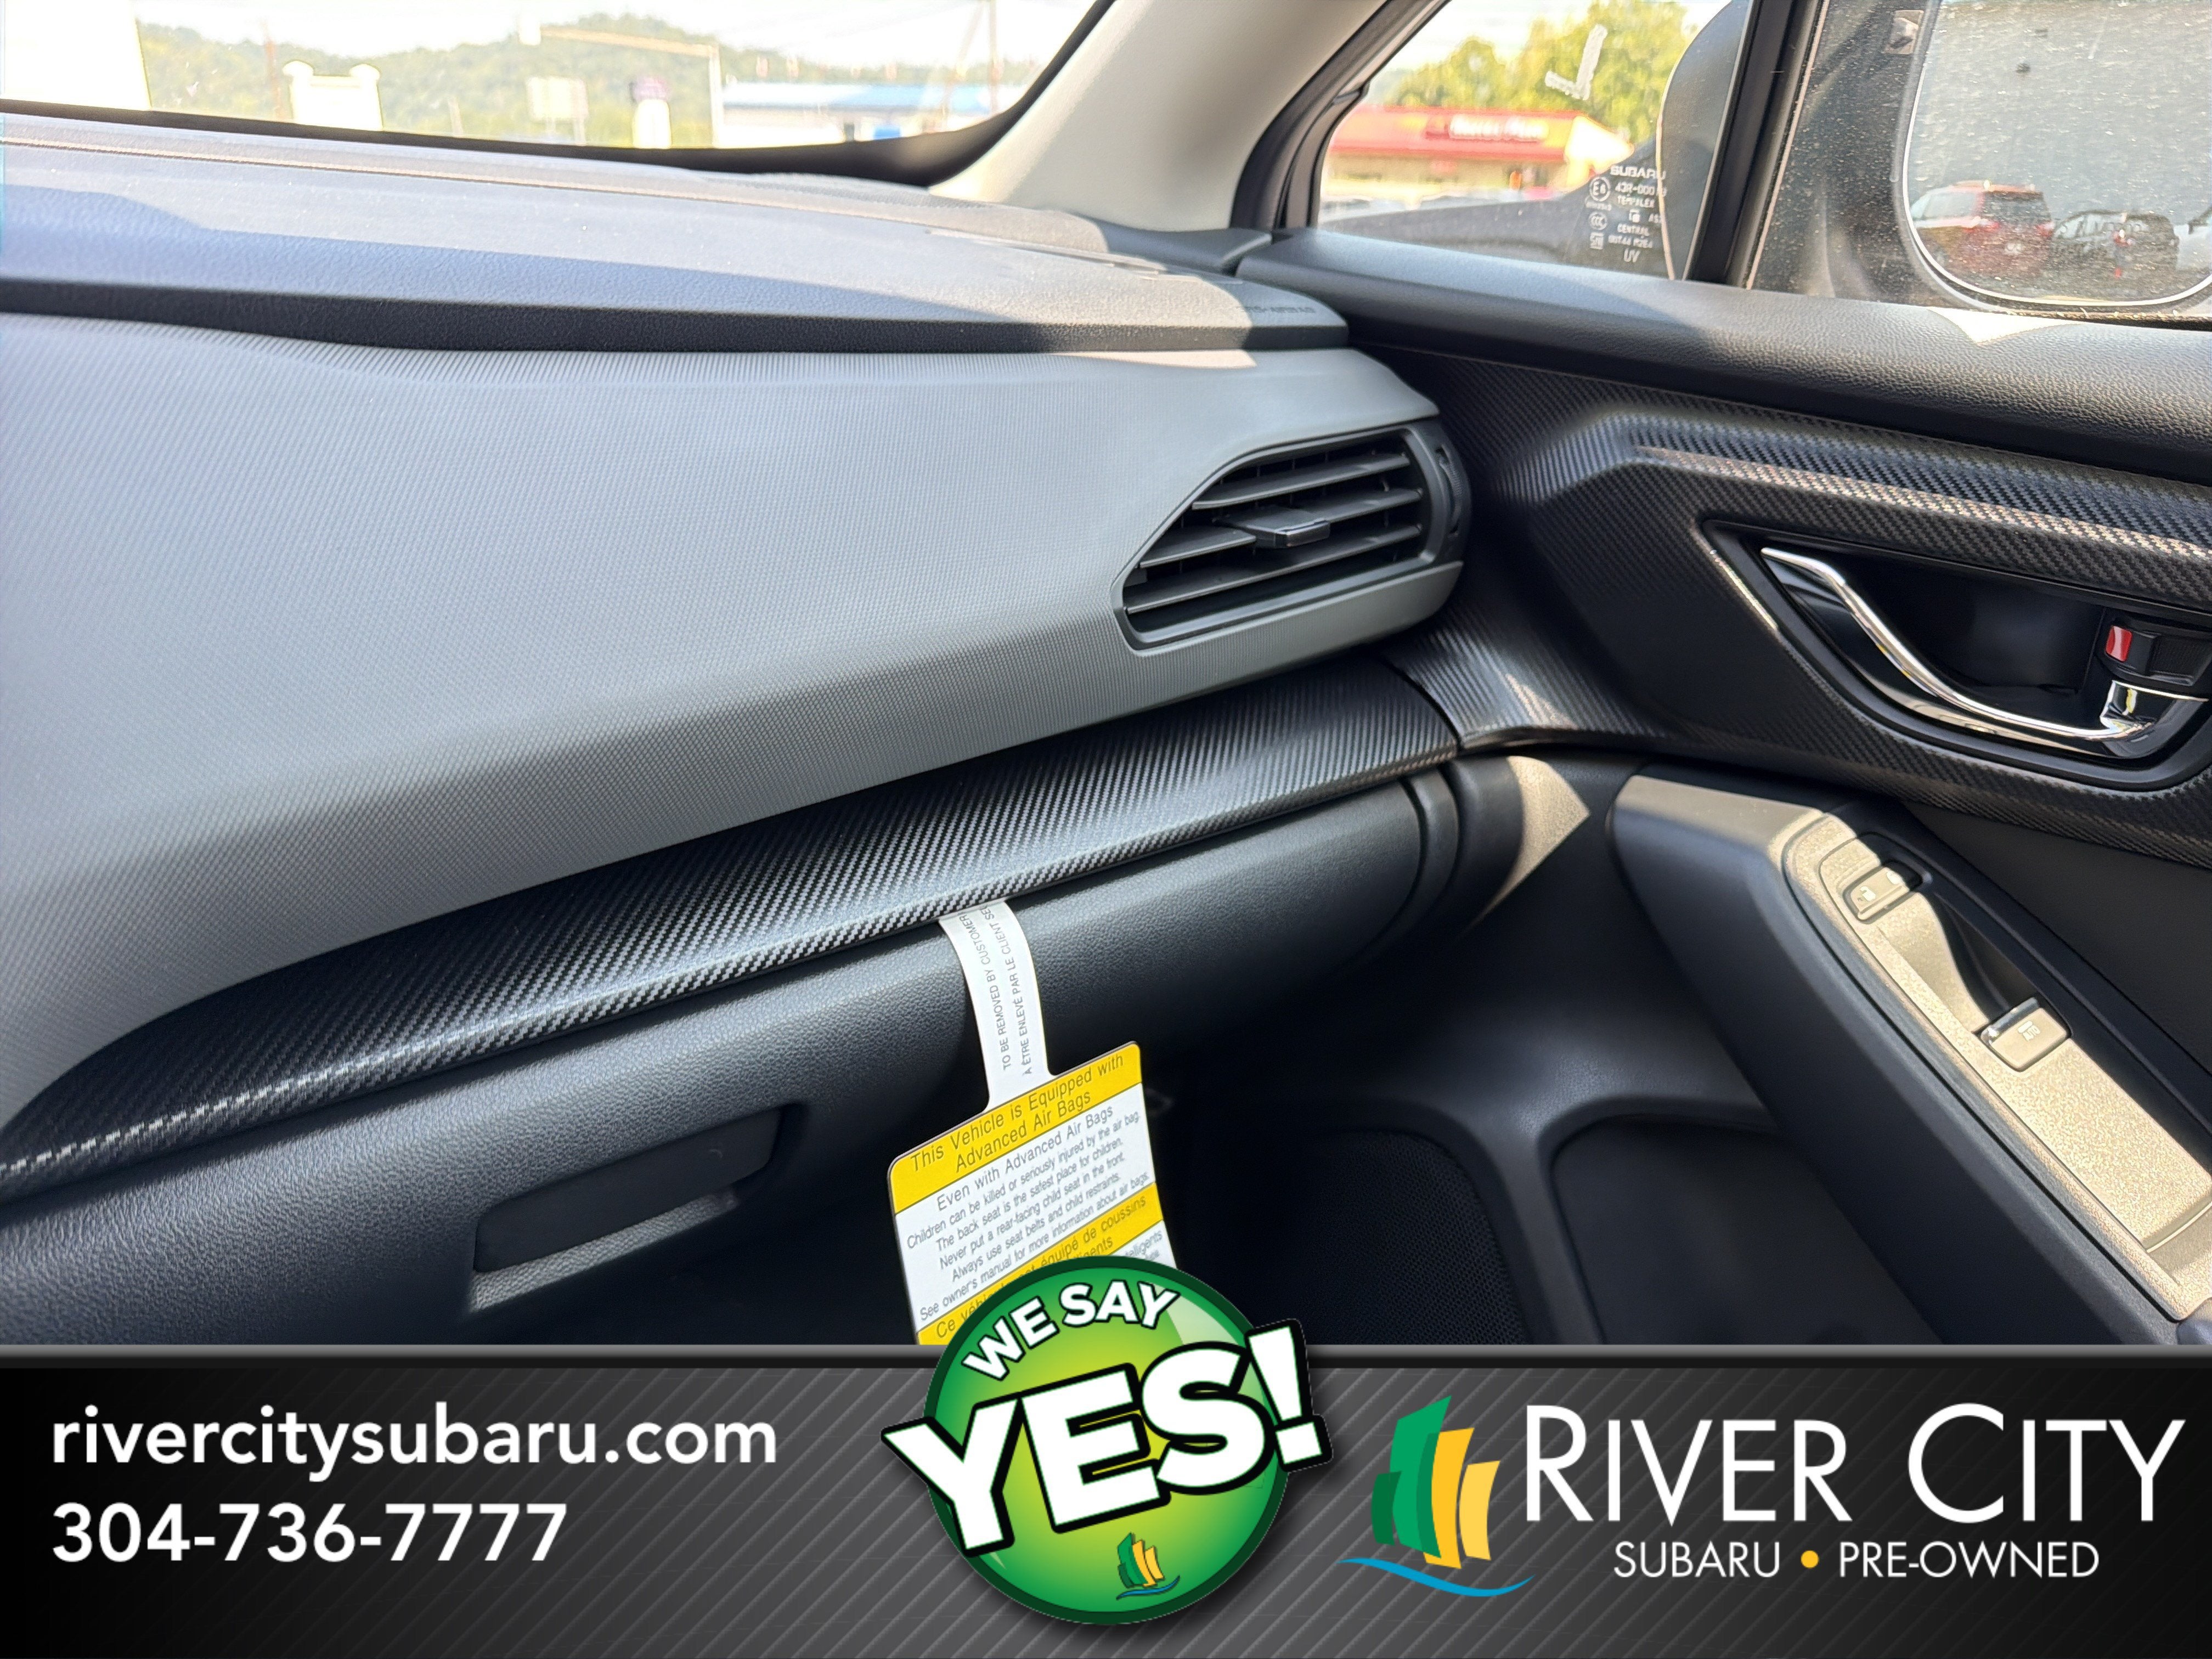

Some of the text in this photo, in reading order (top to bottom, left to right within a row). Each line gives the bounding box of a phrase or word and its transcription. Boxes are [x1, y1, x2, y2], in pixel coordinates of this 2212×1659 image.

[1610, 166, 1666, 180] SUBARU
[1623, 247, 1641, 263] UV
[989, 923, 1011, 955] CLIENT
[1005, 957, 1016, 970] LE
[1009, 973, 1021, 995] PAR
[959, 915, 1012, 1070] TO BE REMOVED BY CUSTOMER
[911, 1054, 1124, 1171] This Vehicle is Equipped with
[936, 1105, 1113, 1211] Even with Advanced Air Bags
[956, 1091, 1091, 1173] Advanced Air Bags
[907, 1220, 946, 1249] Children
[949, 1209, 966, 1225] can
[969, 1200, 980, 1214] be
[983, 1183, 1006, 1205] killed
[1008, 1179, 1017, 1191] or
[1021, 1157, 1055, 1184] seriously
[1058, 1139, 1084, 1163] injured
[1086, 1135, 1096, 1148] by
[1098, 1126, 1110, 1140] the
[1113, 1119, 1122, 1132] air
[936, 1234, 955, 1251] The
[957, 1219, 979, 1240] back
[983, 1206, 1001, 1226] seat
[1003, 1201, 1011, 1213] is
[1013, 1192, 1027, 1207] the
[1030, 1175, 1054, 1198] safest
[1057, 1163, 1077, 1184] place
[1079, 1155, 1090, 1168] for
[940, 1245, 967, 1269] Never
[970, 1235, 985, 1255] put
[988, 1231, 994, 1241] a
[996, 1203, 1041, 1234] rear-facing
[1043, 1187, 1061, 1208] child
[1064, 1177, 1081, 1195] seat
[1082, 1173, 1091, 1184] in
[1092, 1165, 1104, 1178] the
[920, 1302, 939, 1321] See
[943, 1278, 978, 1307] owner's
[980, 1254, 1012, 1283] manual
[1014, 1248, 1025, 1262] for
[1028, 1233, 1049, 1252] more
[1052, 1205, 1094, 1238] information
[1097, 1189, 1117, 1211] about
[1119, 1183, 1128, 1196] air
[936, 1319, 956, 1339] Ce
[1082, 1227, 1096, 1244] de
[1101, 1195, 1146, 1232] coussins
[952, 1256, 984, 1283] Always
[986, 1244, 1002, 1261] use
[1006, 1230, 1023, 1249] seat
[1025, 1218, 1045, 1237] belts
[1048, 1204, 1063, 1223] and
[1065, 1192, 1084, 1212] child
